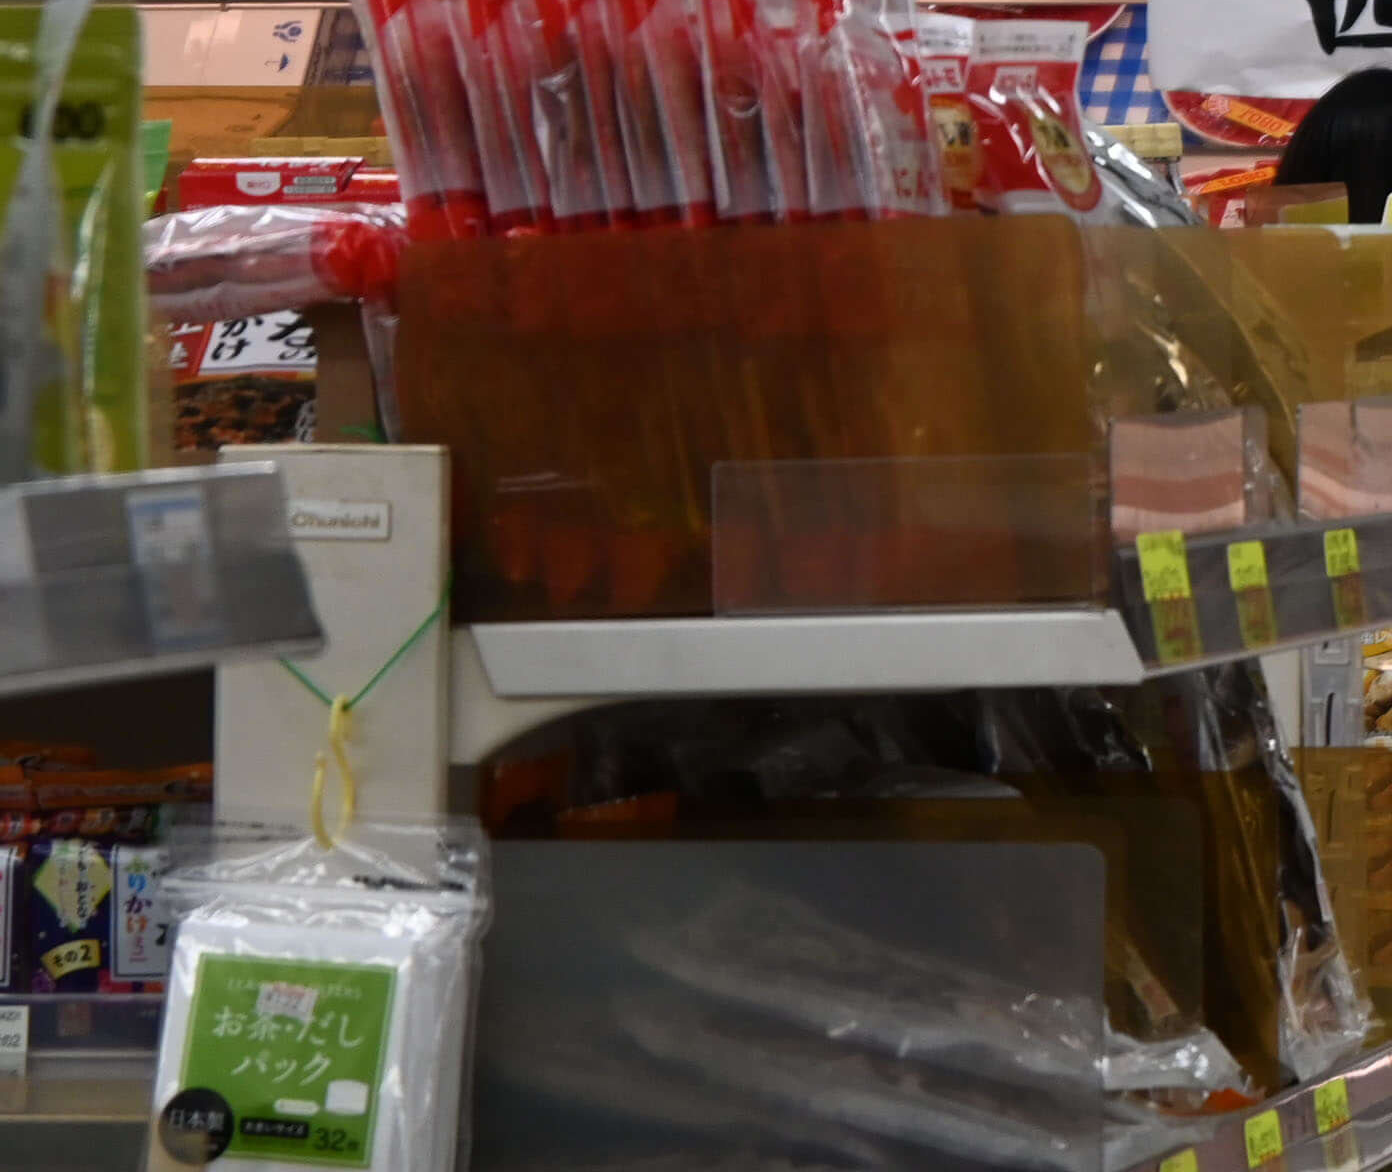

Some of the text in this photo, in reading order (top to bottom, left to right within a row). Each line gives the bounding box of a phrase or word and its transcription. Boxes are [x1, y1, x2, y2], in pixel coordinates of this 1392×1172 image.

[52, 943, 93, 968] その2
[230, 1049, 332, 1086] パック
[168, 1108, 225, 1130] 日本製
